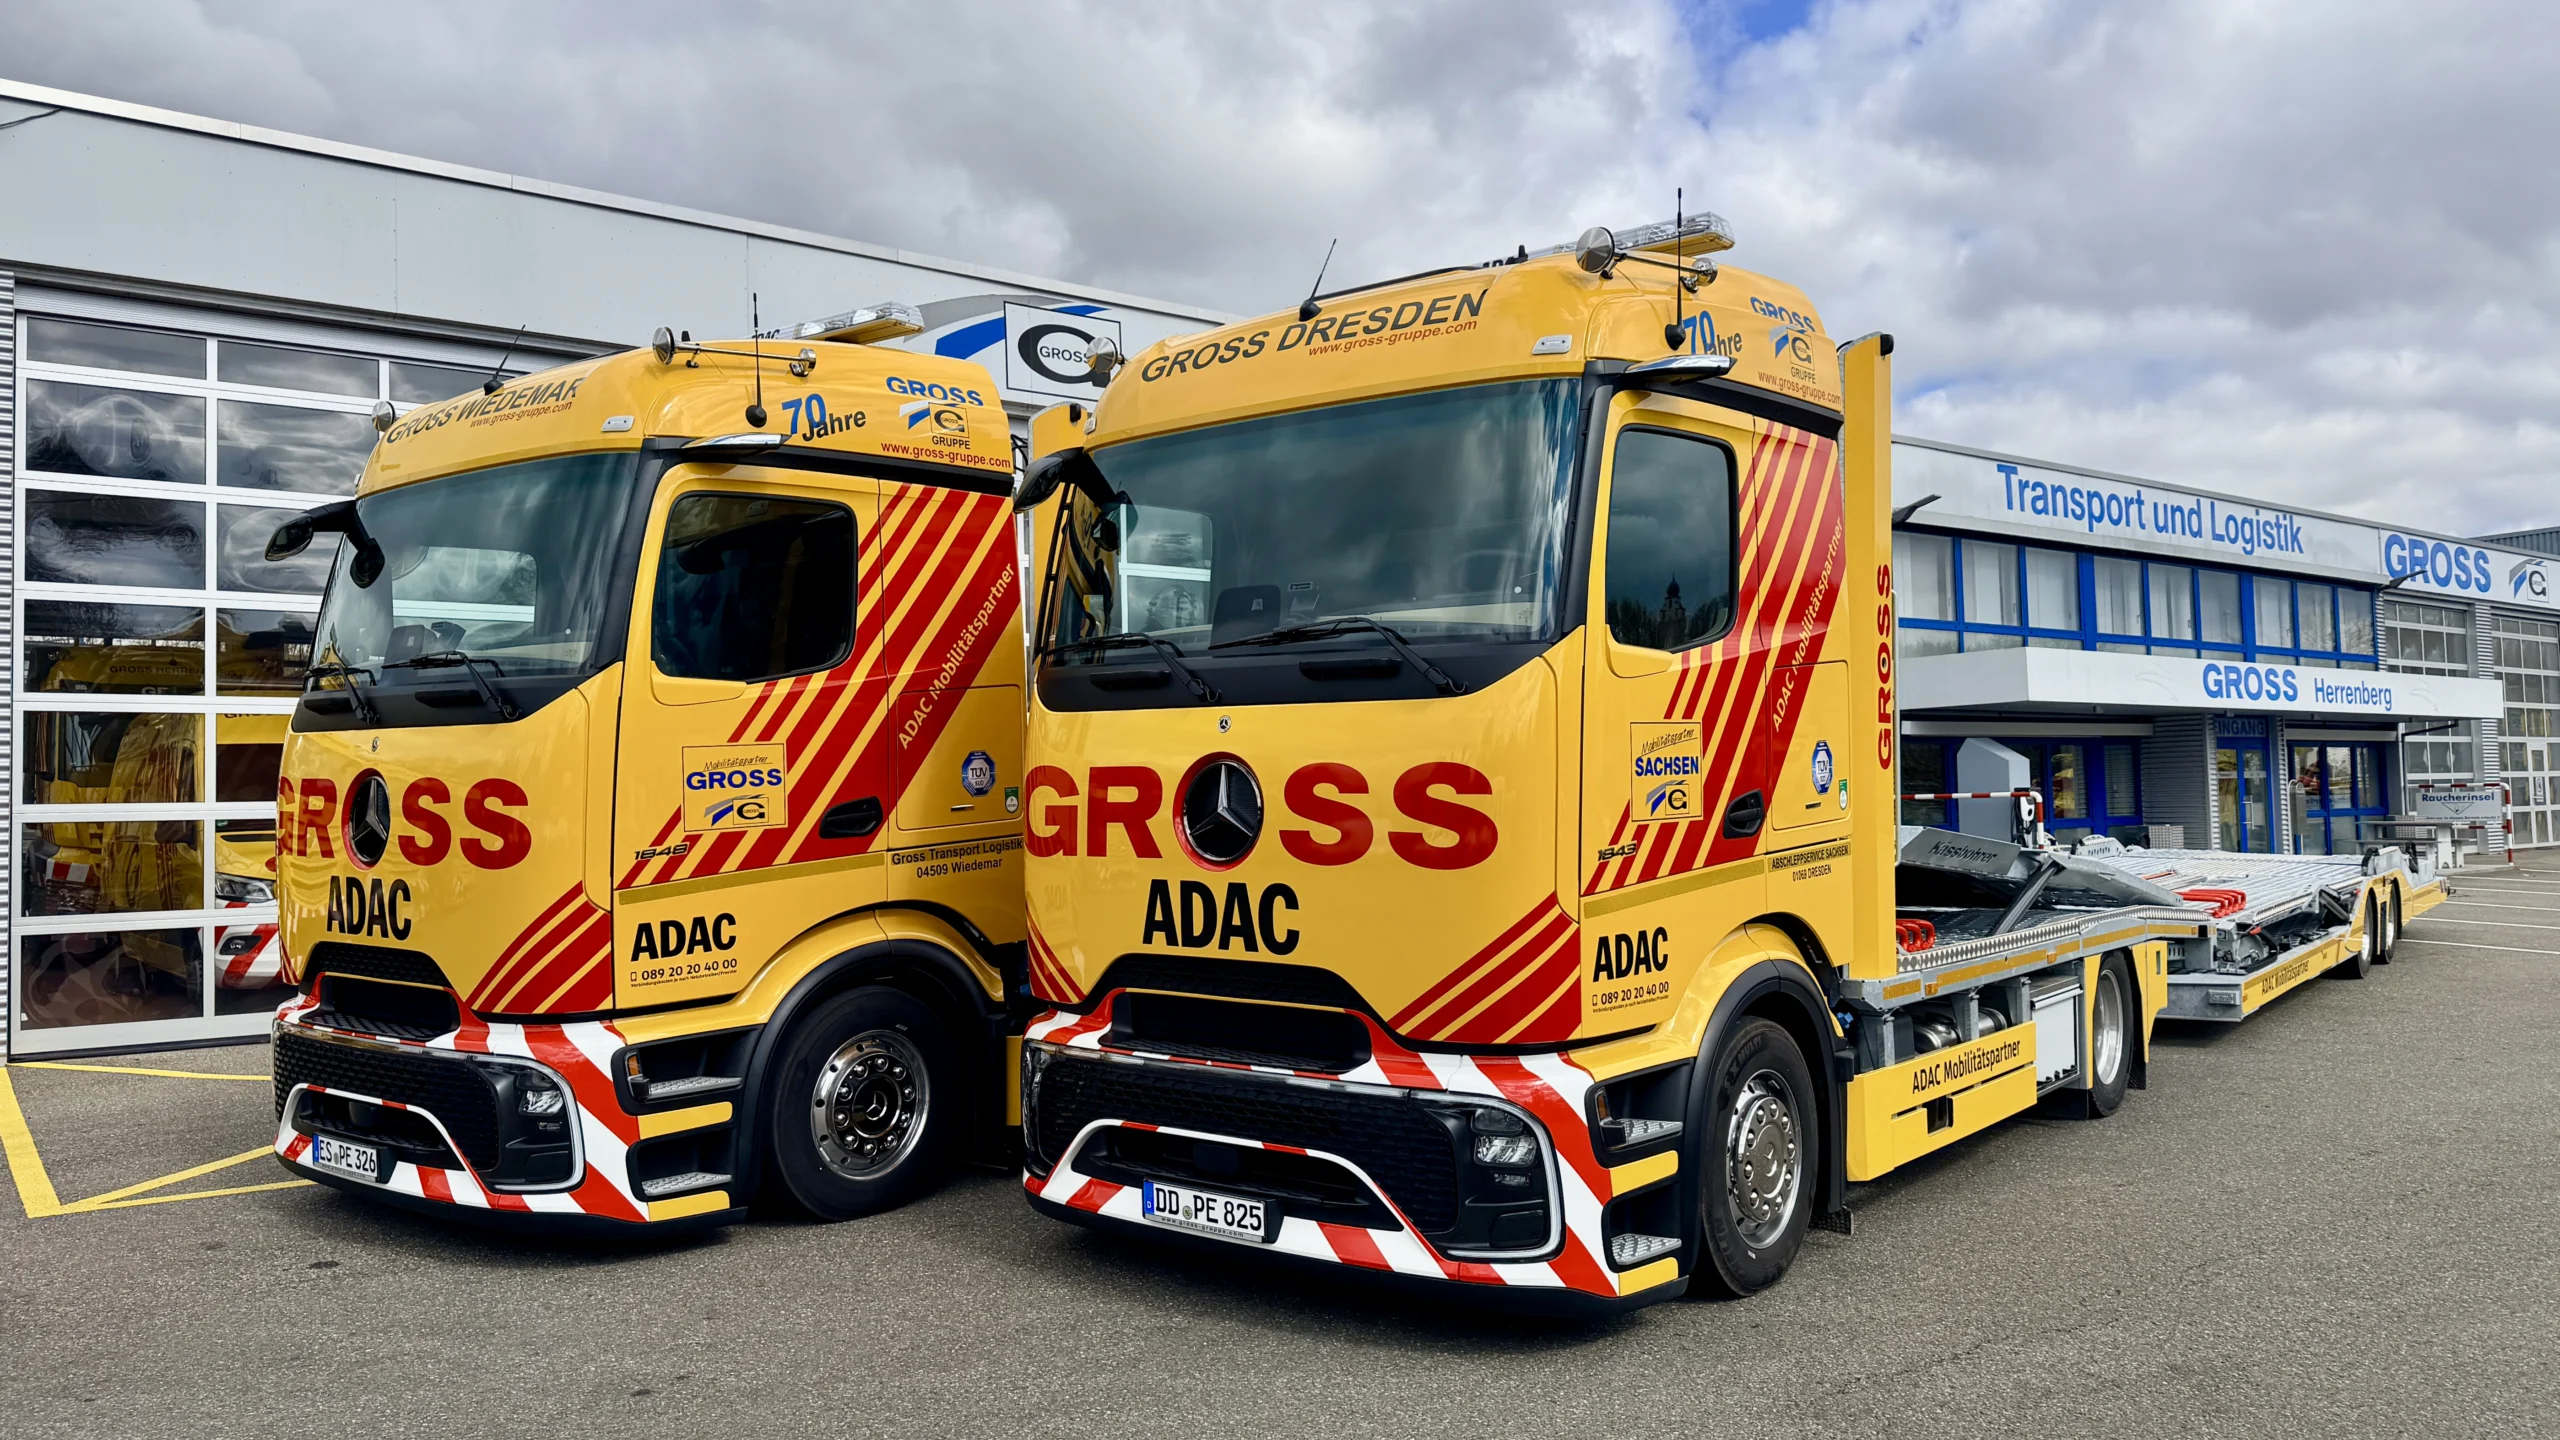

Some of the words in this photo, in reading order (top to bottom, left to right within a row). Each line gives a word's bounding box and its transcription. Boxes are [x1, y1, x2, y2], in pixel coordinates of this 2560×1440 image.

[1750, 296, 1815, 332] GROSS
[1142, 331, 1269, 382] GROSS
[1277, 289, 1489, 351] DRESDEN
[1309, 320, 1477, 356] www.gross-gruppe.com
[1682, 310, 1715, 355] 70
[1708, 333, 1742, 356] ahre
[886, 376, 984, 407] GROSS
[1758, 371, 1842, 405] www.gross-gruppe.com
[1791, 366, 1816, 384] GRUPPE
[387, 404, 458, 444] GROSS
[456, 377, 587, 422] WIEDEMAR
[470, 401, 572, 428] www.gross-gruppe.com
[781, 393, 826, 434] 70
[802, 410, 866, 442] Jahre
[881, 441, 1011, 469] www.gross-gruppe.com
[932, 436, 970, 450] GRUPPE
[1996, 463, 2146, 532] Transport
[2153, 498, 2201, 538] und
[2210, 501, 2304, 555] Logistik
[2384, 533, 2492, 593] GROSS
[1772, 672, 1794, 732] ADAC
[1791, 516, 1843, 675] Mobilitätspartner
[109, 665, 152, 673] GROSS
[899, 697, 932, 750] ADAC
[929, 563, 1015, 700] Mobilitätspartner
[1877, 563, 1892, 770] GROSS
[2203, 663, 2298, 702] GROSS
[2314, 677, 2392, 711] Herrenberg
[2215, 719, 2265, 735] INGANG
[686, 768, 783, 790] GROSS
[970, 766, 988, 777] TÜV
[1635, 756, 1699, 777] SACHSEN
[1024, 751, 1498, 872] GROSS
[2422, 792, 2494, 802] Raucherinsel
[634, 842, 690, 860] 1848
[892, 852, 926, 865] Gross
[929, 845, 980, 860] Transport
[983, 838, 1023, 854] Logistik
[1772, 849, 1824, 870] ABSCHLEPPSERVICE
[1826, 845, 1848, 859] SACHSEN
[916, 863, 948, 878] 04509
[951, 858, 1003, 873] Wiedemar
[1808, 864, 1832, 878] DRESDEN
[326, 875, 412, 941] ADAC
[1142, 878, 1300, 956] ADAC
[630, 912, 737, 962] ADAC
[641, 968, 665, 981] 089
[668, 966, 683, 977] 20
[686, 963, 701, 974] 20
[704, 961, 719, 972] 40
[722, 958, 737, 969] 00
[1592, 926, 1668, 983] ADAC
[1601, 991, 1618, 1005] 089
[1621, 988, 1632, 1001] 20
[1634, 986, 1644, 999] 20
[1646, 983, 1656, 996] 40
[1658, 981, 1669, 993] 00
[1912, 1063, 1940, 1094] ADAC
[1944, 1040, 2020, 1083] Mobilitätspartner
[320, 1140, 332, 1162] ES
[339, 1144, 352, 1168] PE
[355, 1148, 376, 1173] 326
[1155, 1187, 1179, 1215] DD
[1193, 1195, 1219, 1224] PE
[1223, 1201, 1262, 1231] 825
